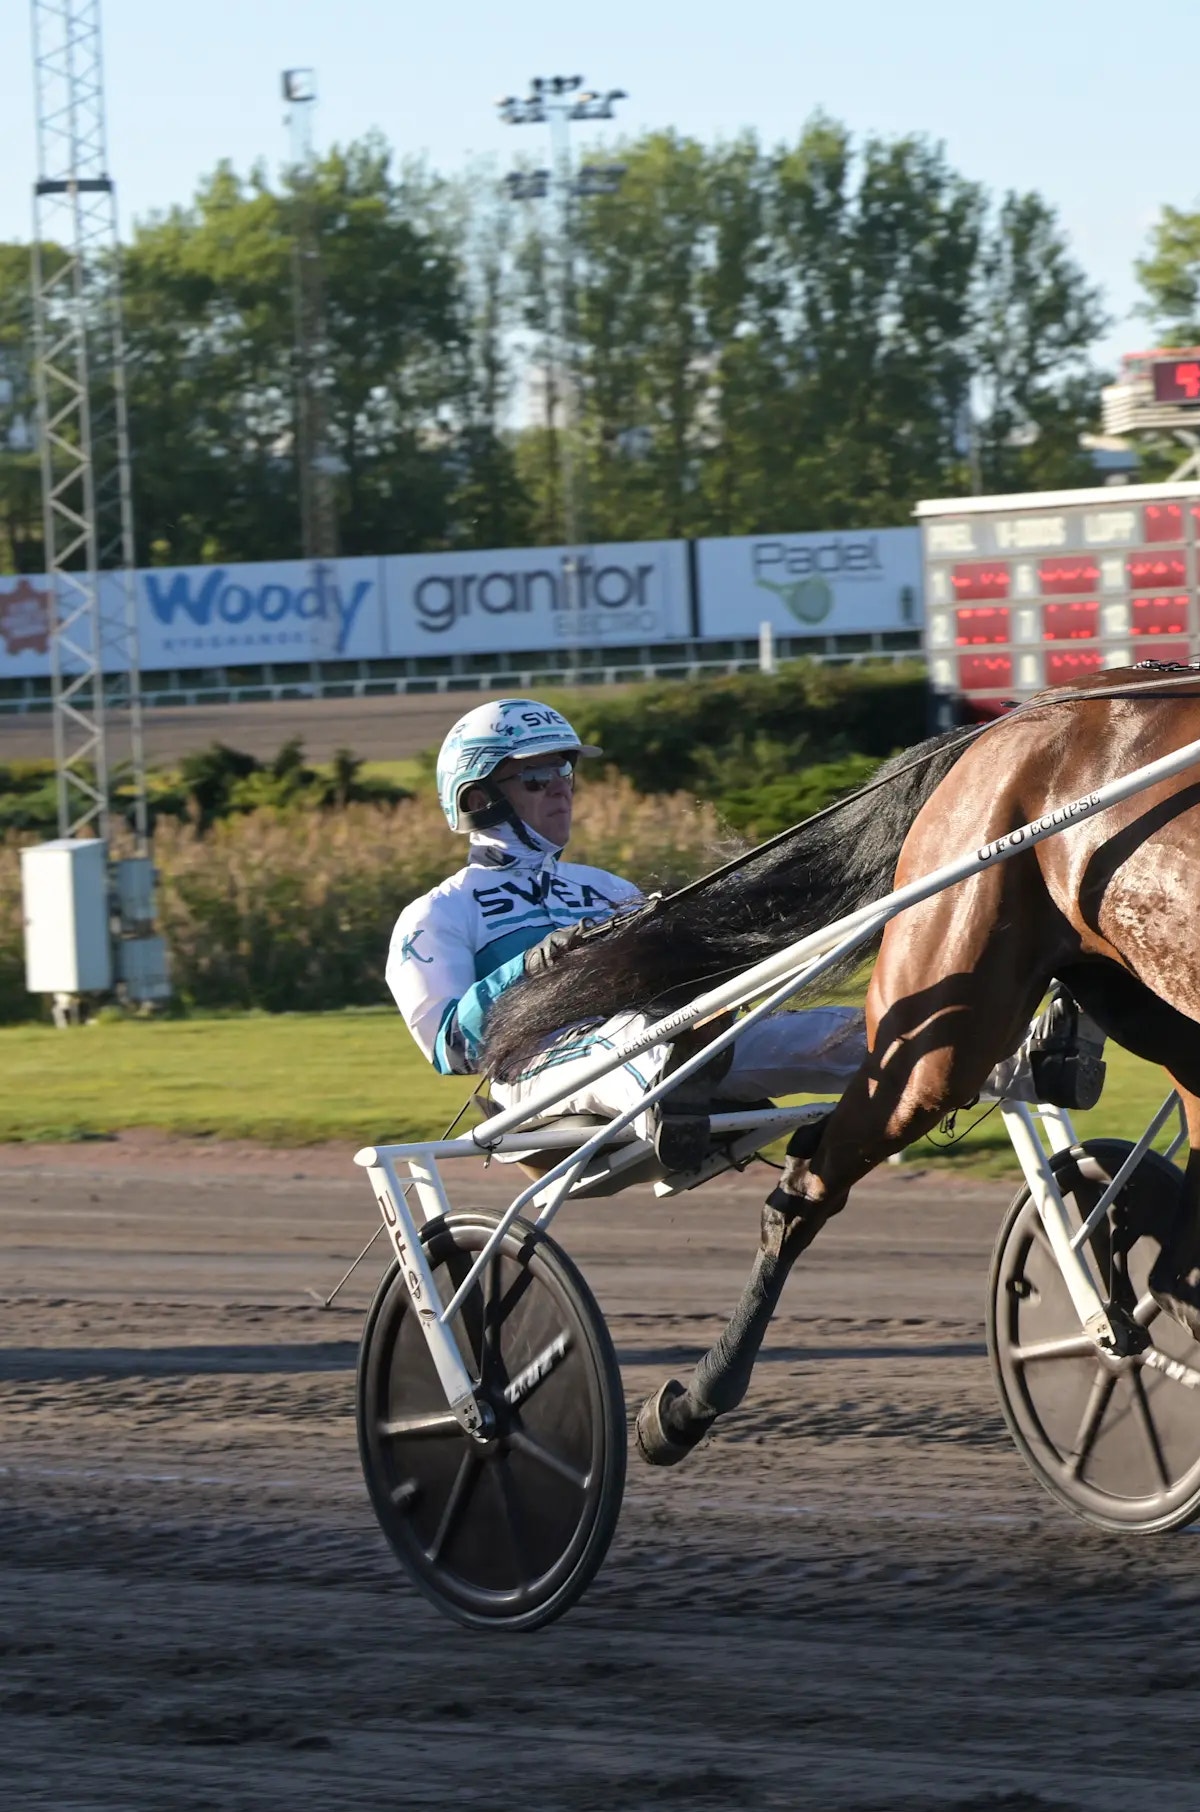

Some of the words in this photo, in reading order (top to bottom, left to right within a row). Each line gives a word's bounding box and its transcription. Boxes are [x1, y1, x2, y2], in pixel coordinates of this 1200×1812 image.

[752, 536, 884, 578] Padel
[143, 567, 375, 653] Woody
[413, 554, 655, 634] granitor
[976, 829, 1026, 861] UFO
[1029, 791, 1101, 837] ECLIPSE
[473, 872, 617, 918] SVEA
